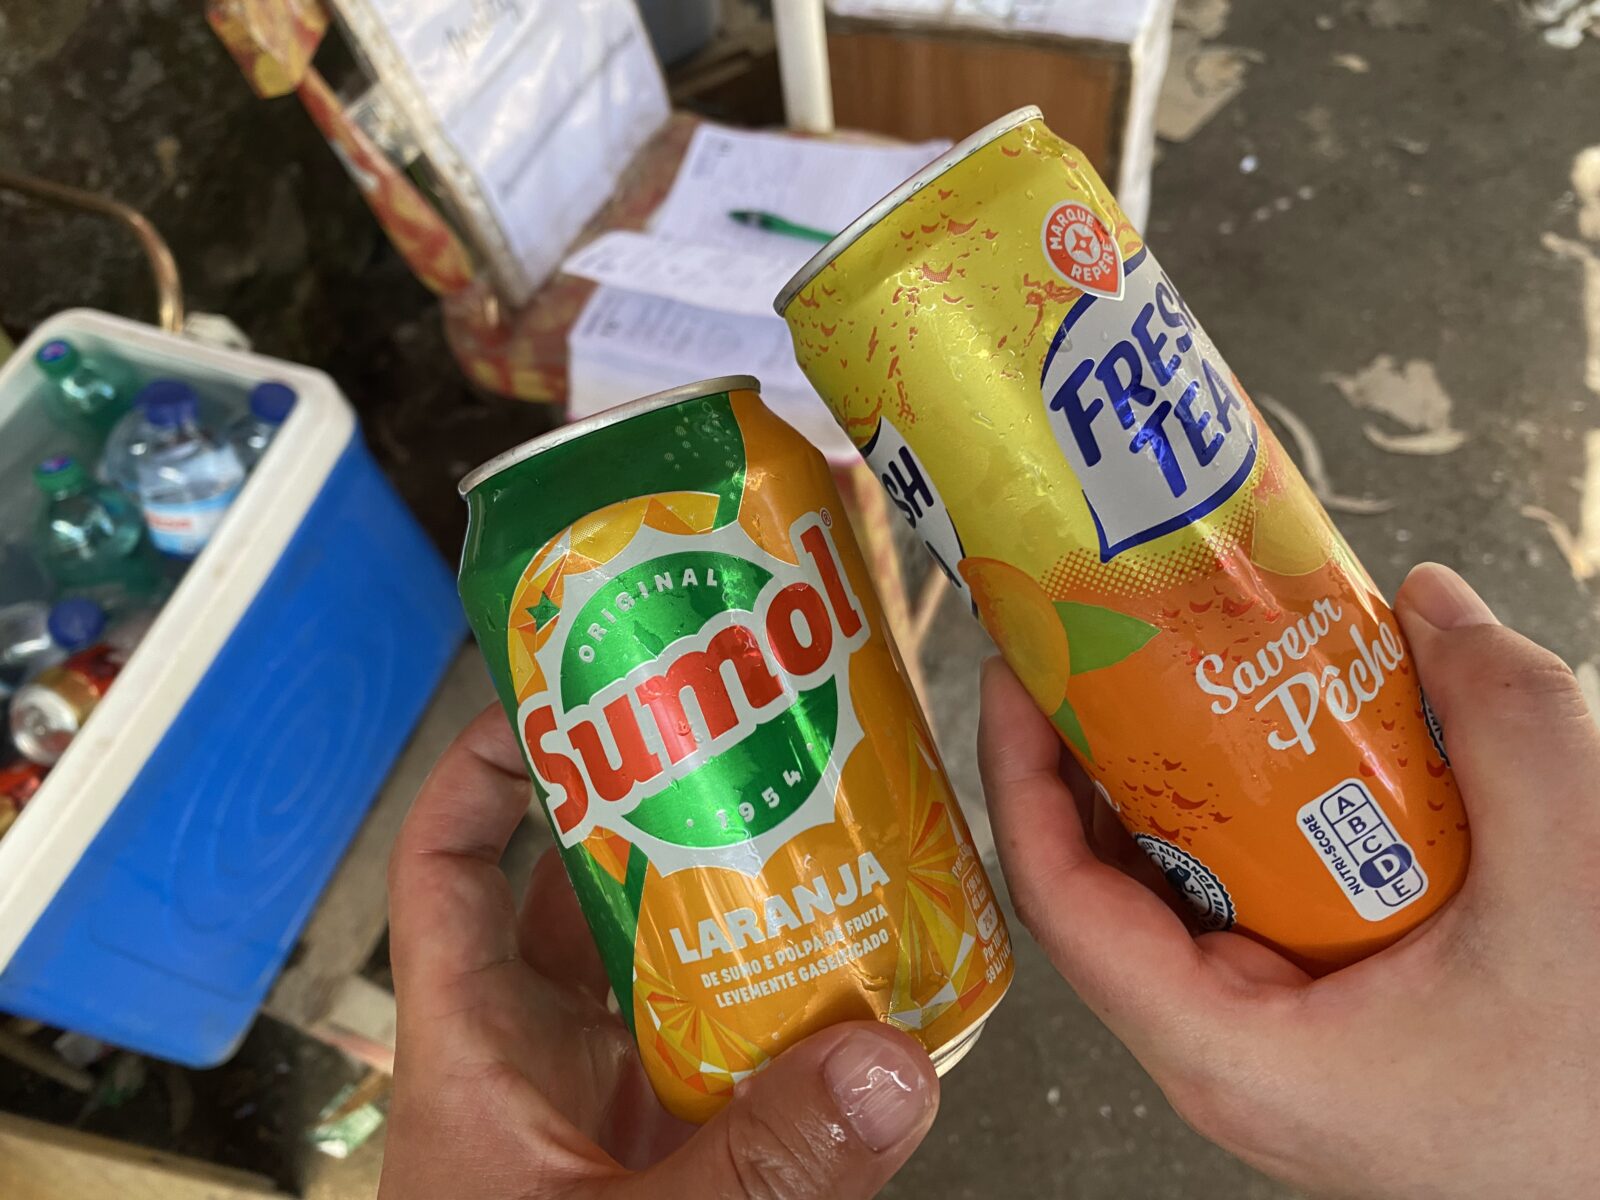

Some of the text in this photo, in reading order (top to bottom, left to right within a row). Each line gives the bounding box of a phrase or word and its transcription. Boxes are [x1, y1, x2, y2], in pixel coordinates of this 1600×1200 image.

[1049, 207, 1095, 250] MARQUE
[1129, 358, 1241, 498] TEA
[578, 567, 719, 664] ORIGINAL
[1195, 598, 1343, 715] Saveur
[523, 524, 863, 835] Sumol
[1254, 622, 1405, 755] Pêche
[716, 769, 802, 831] 1954
[1337, 796, 1412, 898] A B C D E
[1158, 845, 1216, 890] ALLIANCE
[1302, 813, 1365, 896] NUTRI-SCORE
[669, 851, 891, 965] LARANJA
[701, 904, 889, 989] DE SUMO E POLPA DE FRUTA
[715, 928, 890, 1009] LEVEMENTE GASEIFICADO
